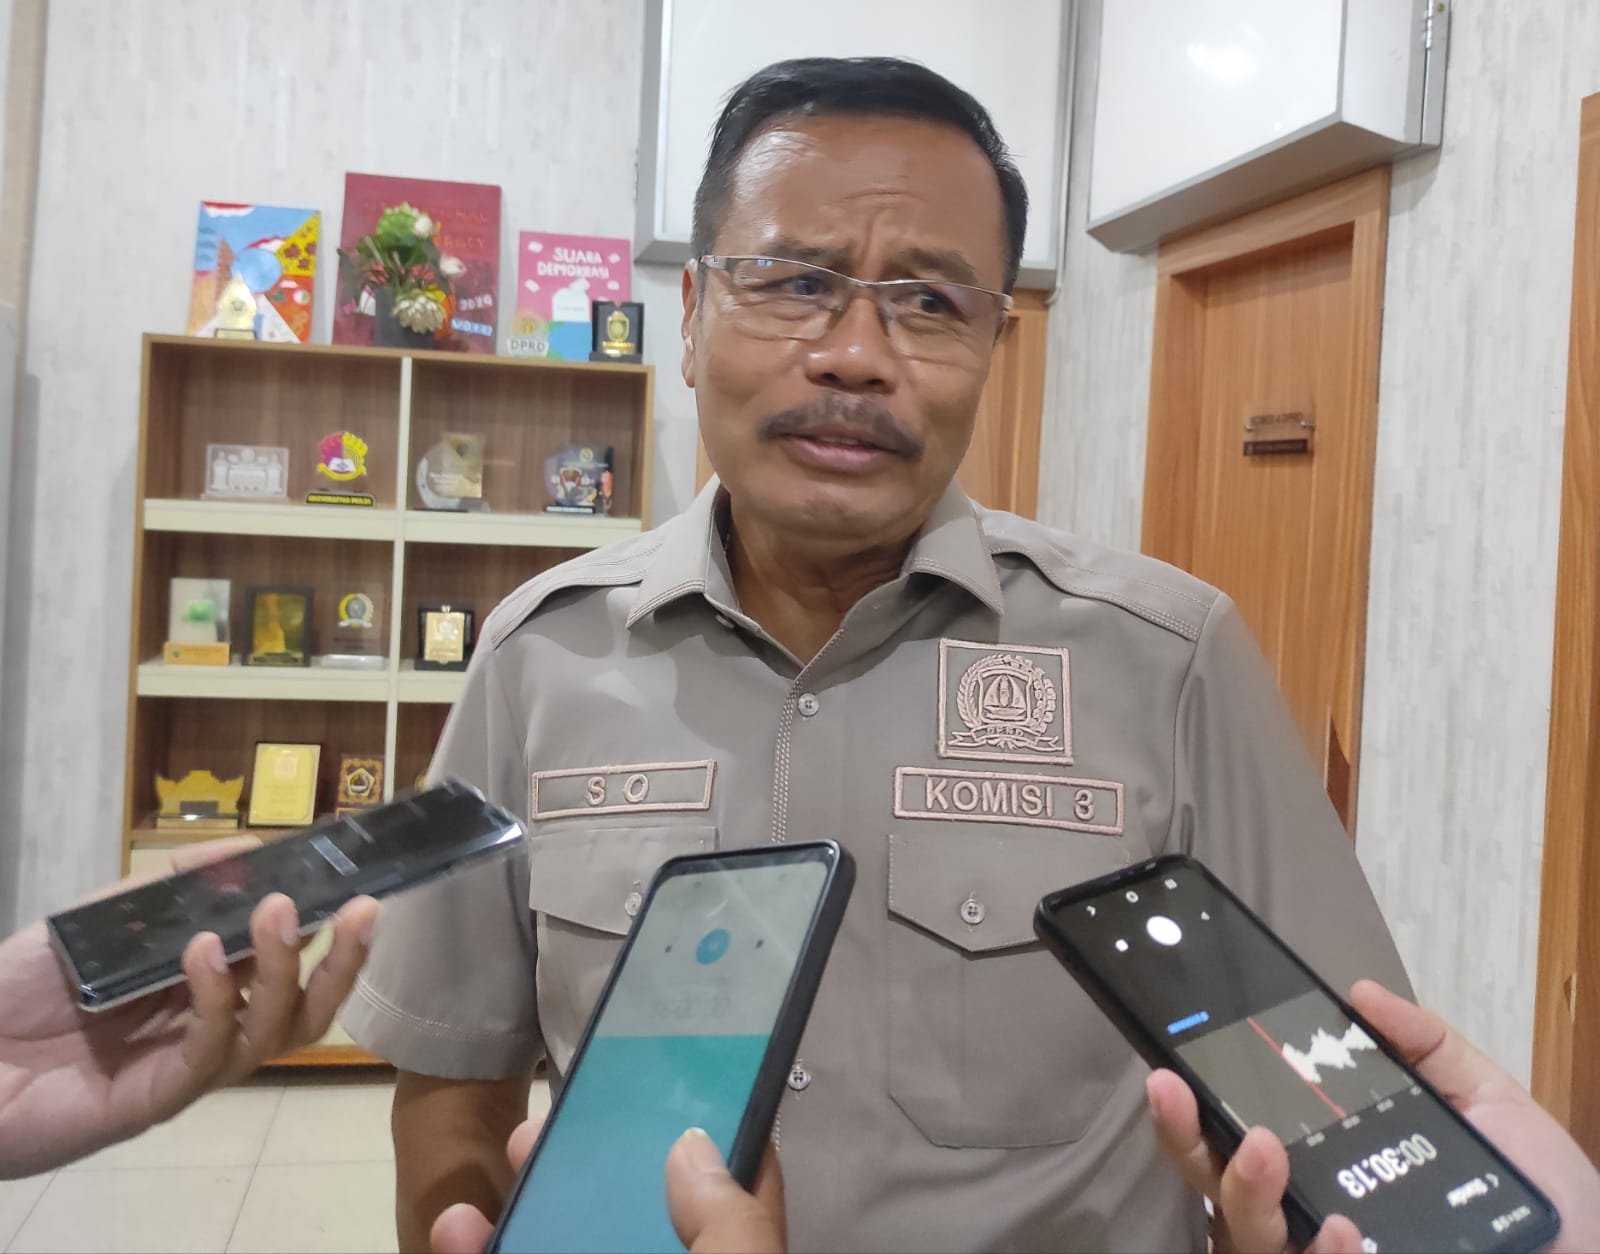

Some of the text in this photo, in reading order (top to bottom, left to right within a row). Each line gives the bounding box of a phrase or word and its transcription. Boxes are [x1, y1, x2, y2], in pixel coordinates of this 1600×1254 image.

[553, 248, 602, 263] SUARA
[536, 261, 610, 279] DEMOKRASI
[510, 339, 546, 352] DPRD
[985, 725, 1025, 737] DPRD
[925, 774, 1097, 821] KOMISI 3
[1336, 1132, 1438, 1199] 00:30.13
